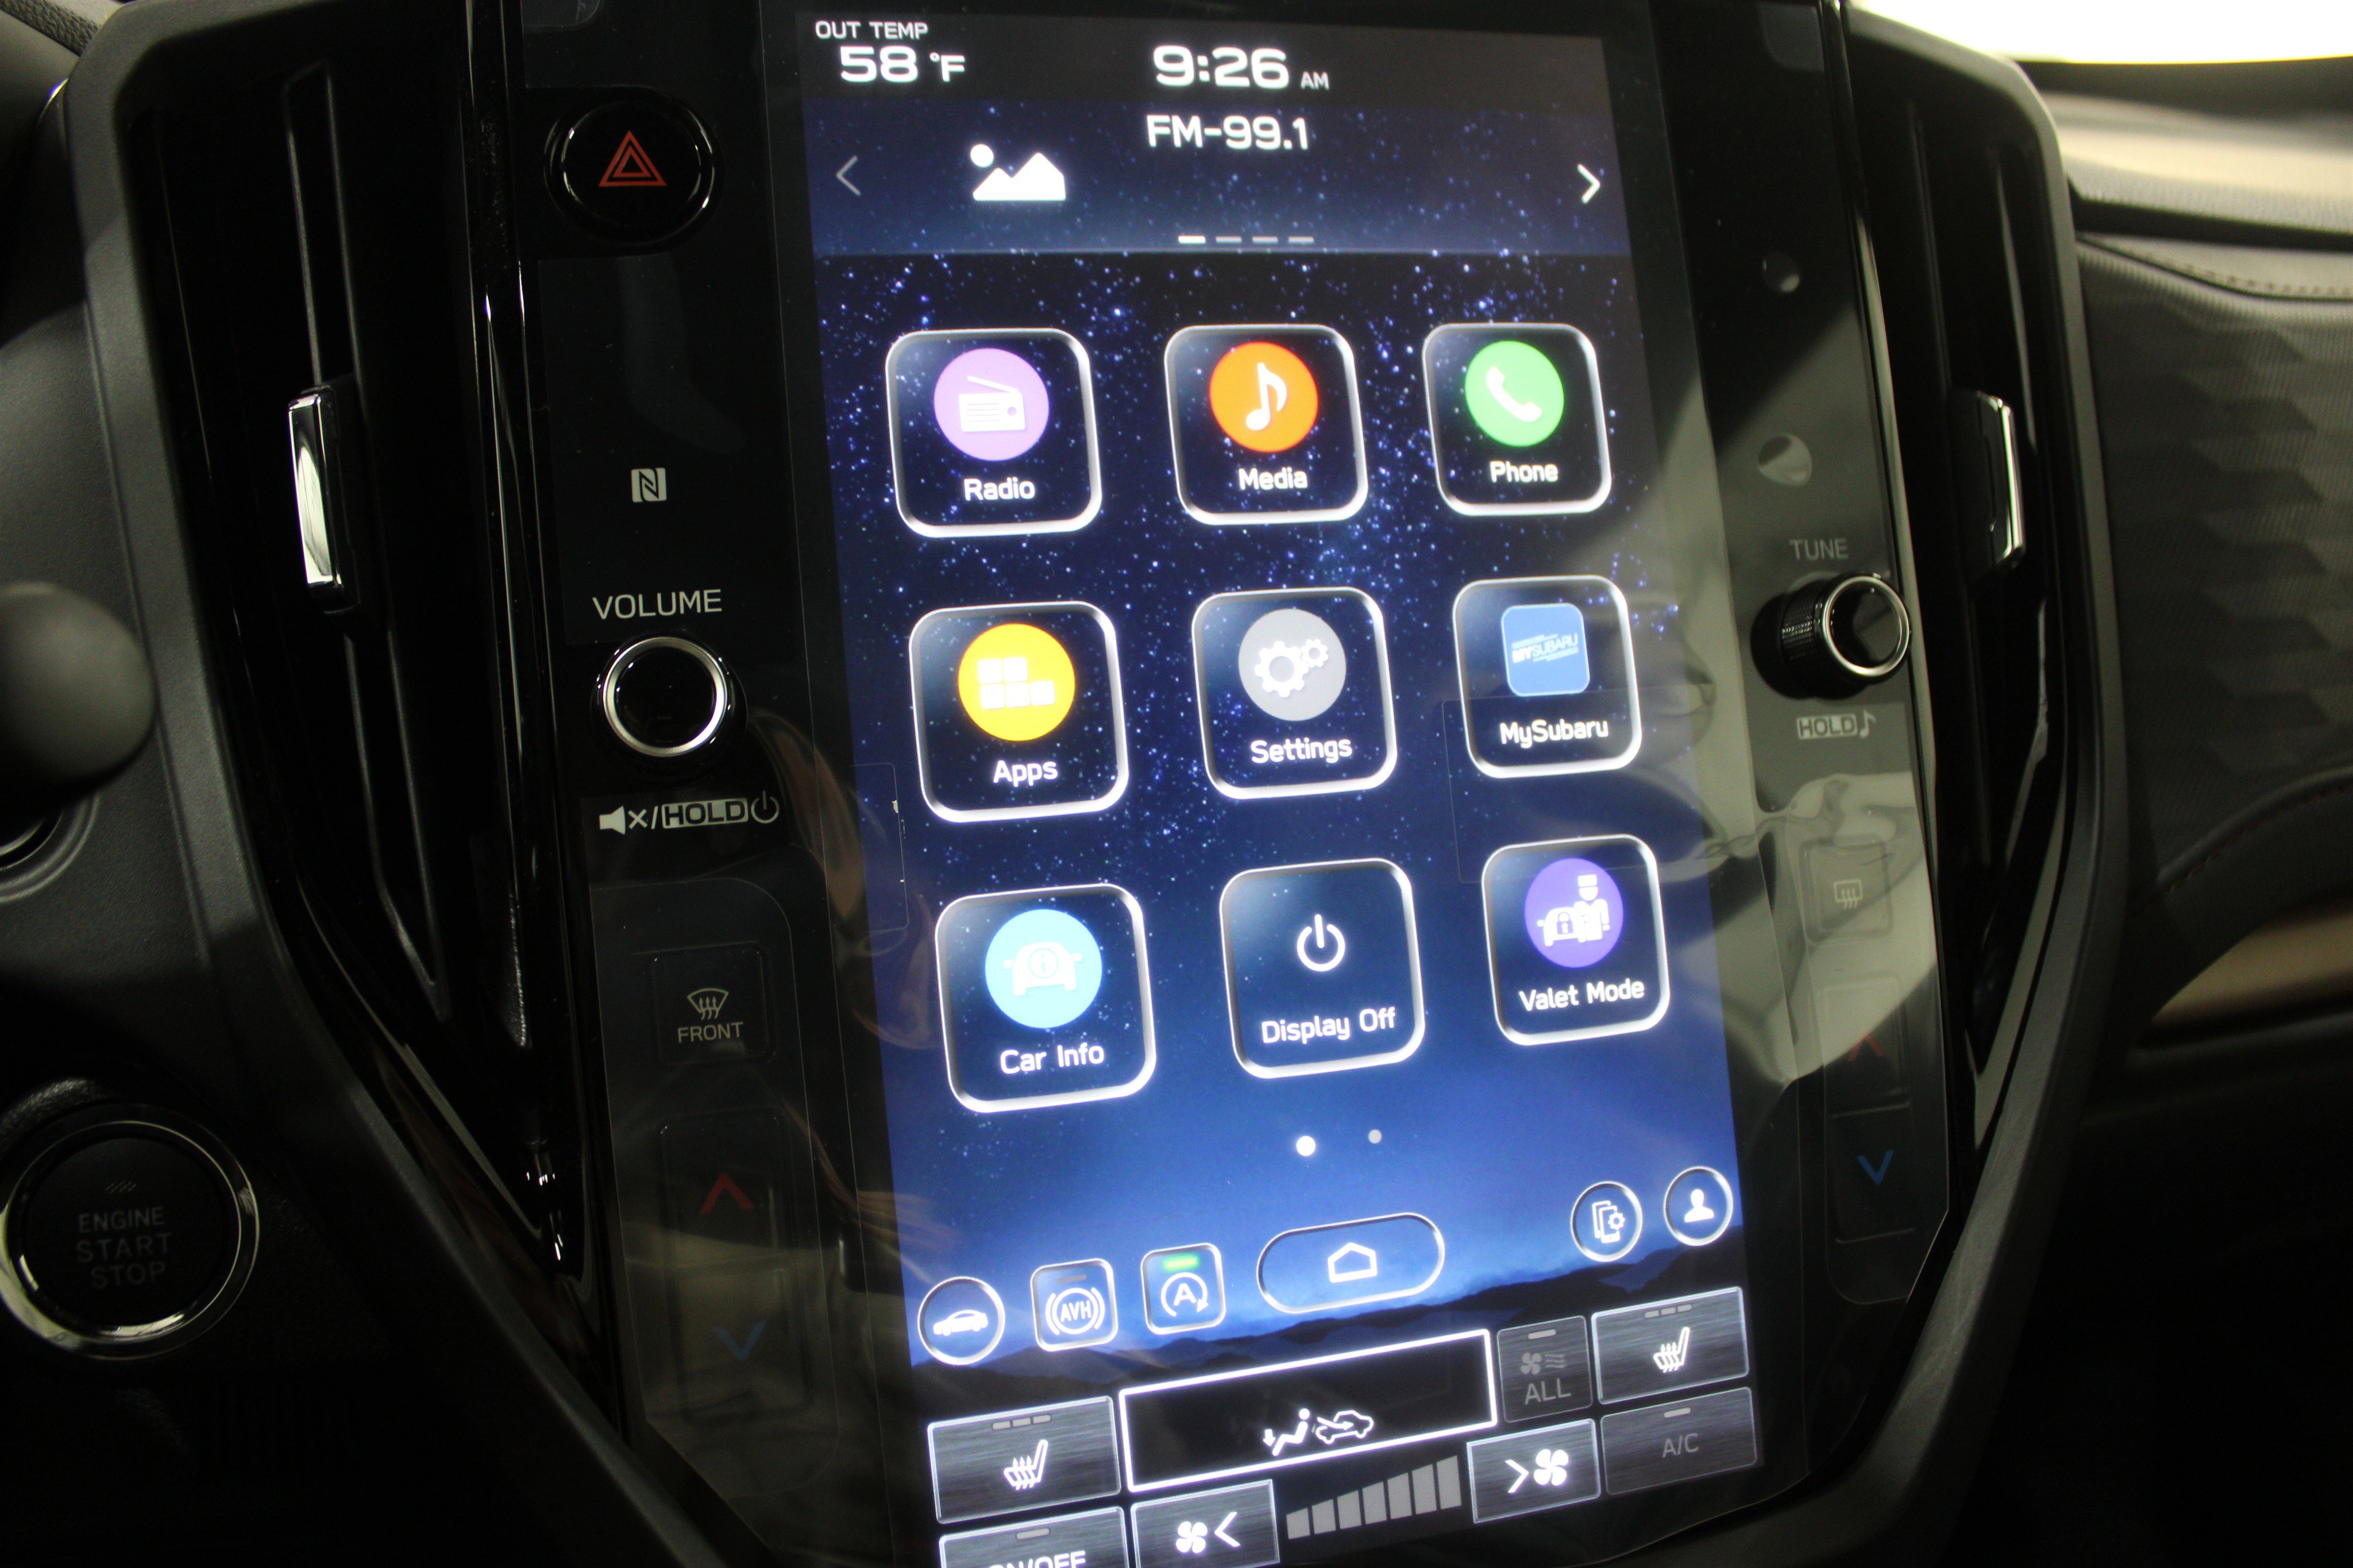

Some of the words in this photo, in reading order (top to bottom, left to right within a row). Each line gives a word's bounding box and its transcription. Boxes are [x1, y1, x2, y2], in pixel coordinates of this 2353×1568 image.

[815, 20, 862, 40] OUT
[868, 21, 929, 40] TEMP
[839, 45, 919, 83] 58
[1152, 44, 1290, 90] 9:26
[1299, 71, 1330, 90] AM
[1146, 114, 1309, 150] FM-99.1
[1237, 467, 1308, 491] Media
[1489, 460, 1559, 484] Phone
[963, 477, 1035, 501] Radio
[1788, 538, 1850, 561] TUNE
[592, 589, 723, 620] VOLUME
[1499, 718, 1609, 749] MySubaru
[1798, 715, 1857, 739] HOLD
[1250, 736, 1353, 764] Settings
[993, 759, 1058, 788] Apps
[1518, 984, 1579, 1012] Valet
[1586, 978, 1645, 1005] Mode
[677, 1021, 745, 1044] FRONT
[1260, 1014, 1351, 1045] Display
[1359, 1006, 1397, 1033] Off
[1000, 1049, 1047, 1075] Car
[1056, 1042, 1105, 1068] Info
[78, 1207, 167, 1234] ENGINE
[76, 1231, 172, 1263] START
[90, 1261, 167, 1290] STOP
[1059, 1299, 1092, 1323] AVH
[1524, 1378, 1572, 1405] ALL
[1661, 1432, 1700, 1459] A/C
[988, 1550, 1086, 1568] OFF
